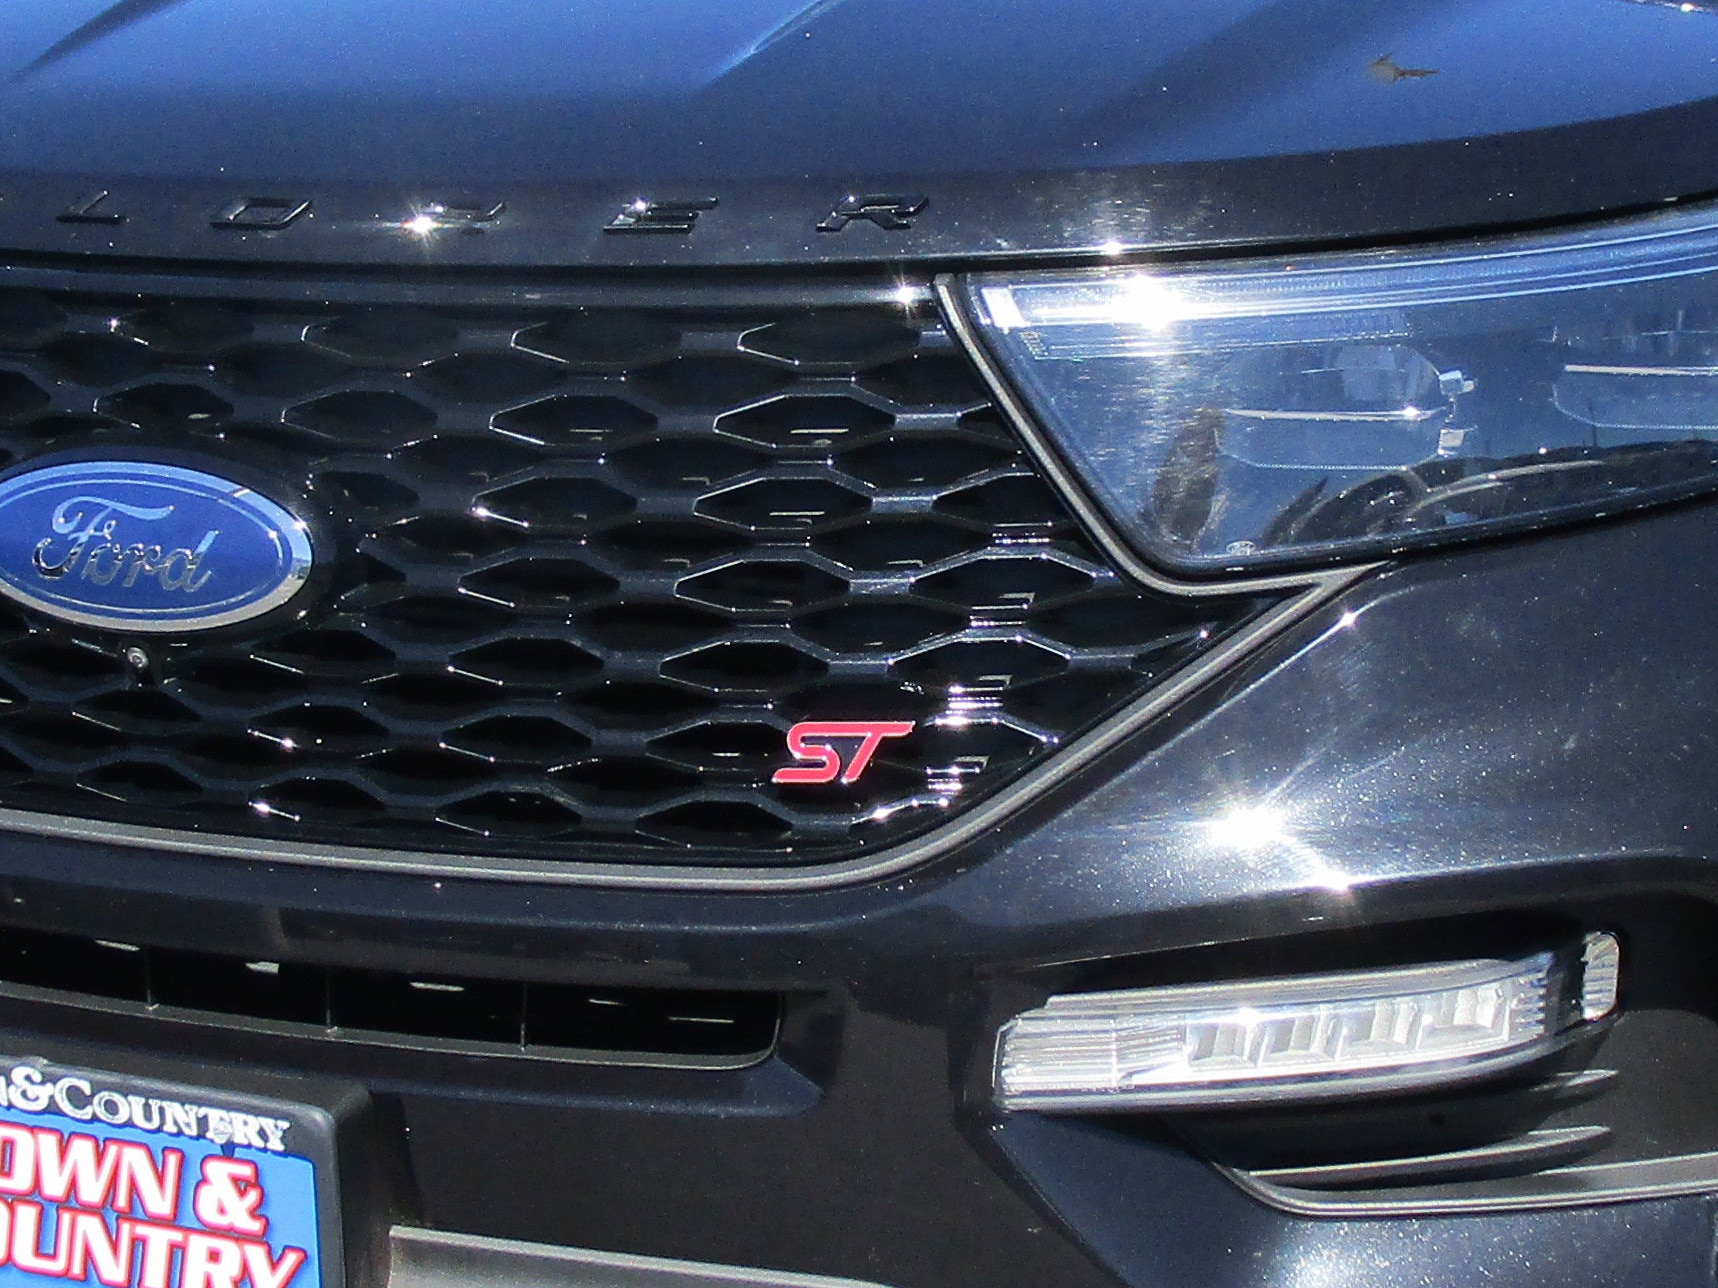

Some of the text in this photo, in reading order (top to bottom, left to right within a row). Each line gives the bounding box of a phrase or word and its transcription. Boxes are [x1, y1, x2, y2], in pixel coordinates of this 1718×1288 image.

[31, 495, 222, 594] Ford
[771, 720, 917, 784] ST
[193, 1155, 267, 1238] &
